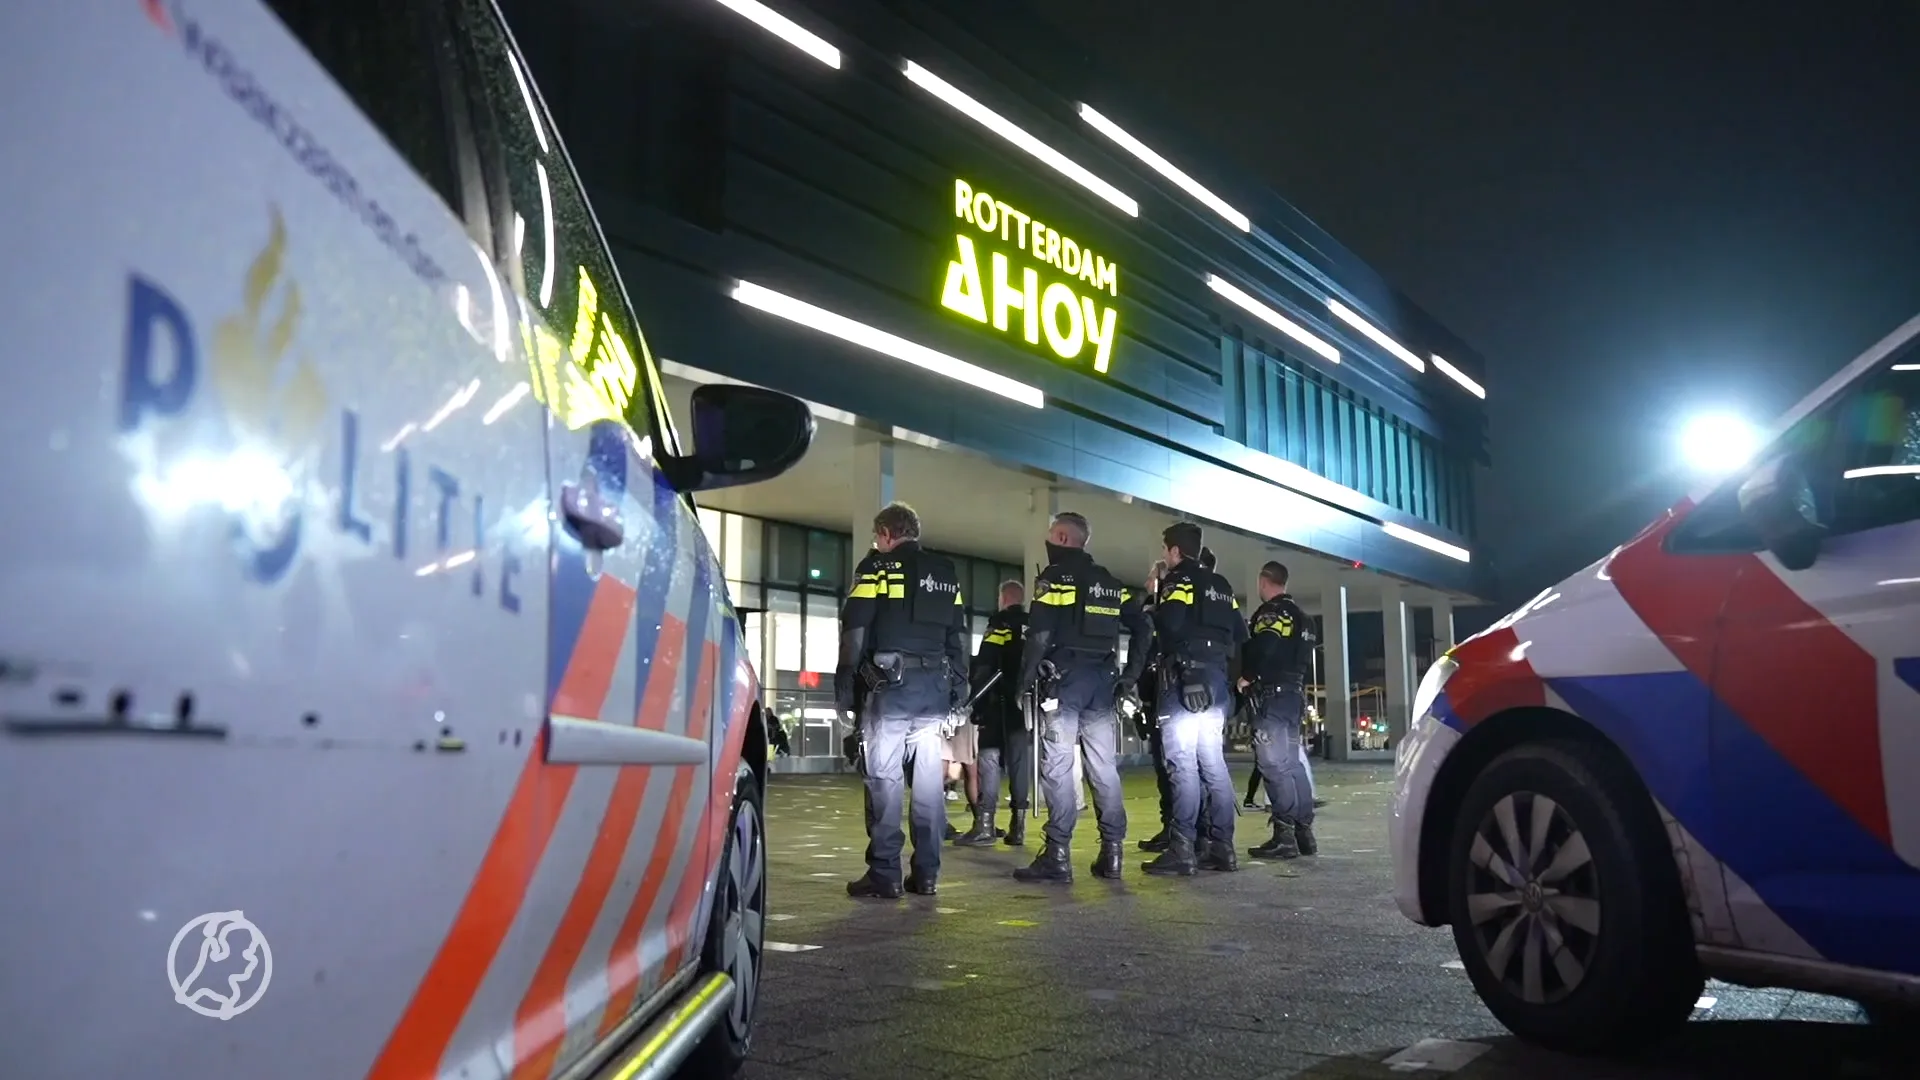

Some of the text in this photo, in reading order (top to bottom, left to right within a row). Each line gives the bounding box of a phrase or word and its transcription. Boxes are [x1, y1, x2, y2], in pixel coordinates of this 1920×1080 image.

[955, 178, 1117, 297] ROTTERDAM
[941, 234, 1117, 374] AHOY
[919, 576, 957, 595] POLITIE
